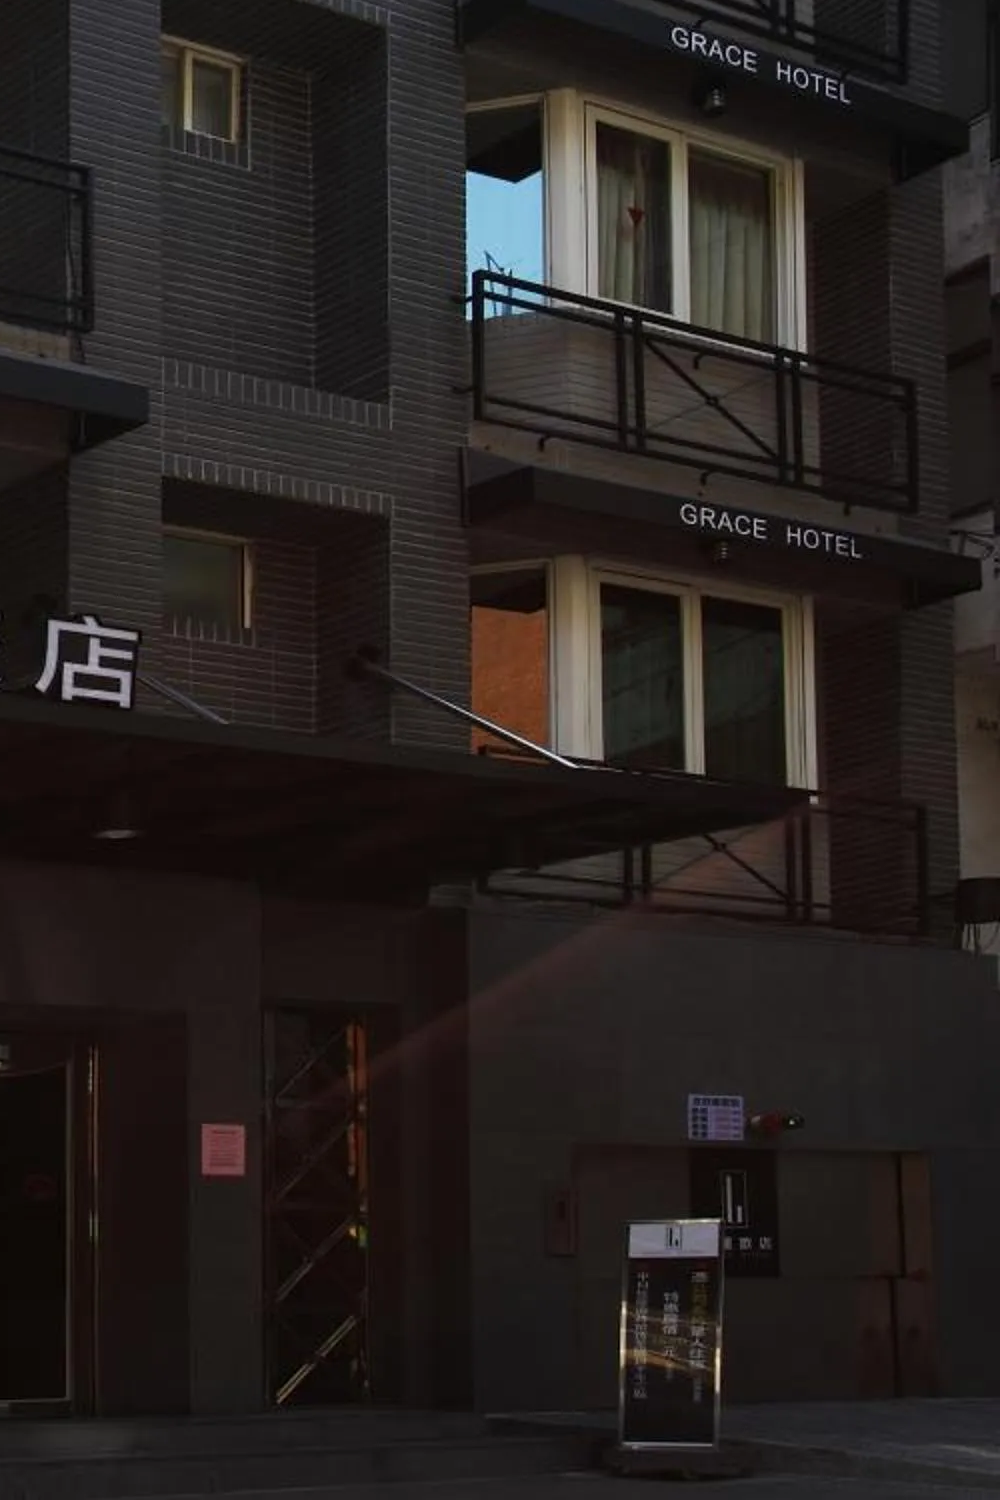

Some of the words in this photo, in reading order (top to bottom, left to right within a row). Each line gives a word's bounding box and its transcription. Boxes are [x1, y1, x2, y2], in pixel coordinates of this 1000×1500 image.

[671, 27, 758, 73] GRACE
[776, 61, 852, 104] HOTEL
[679, 503, 767, 539] GRACE
[786, 525, 862, 559] HOTEL
